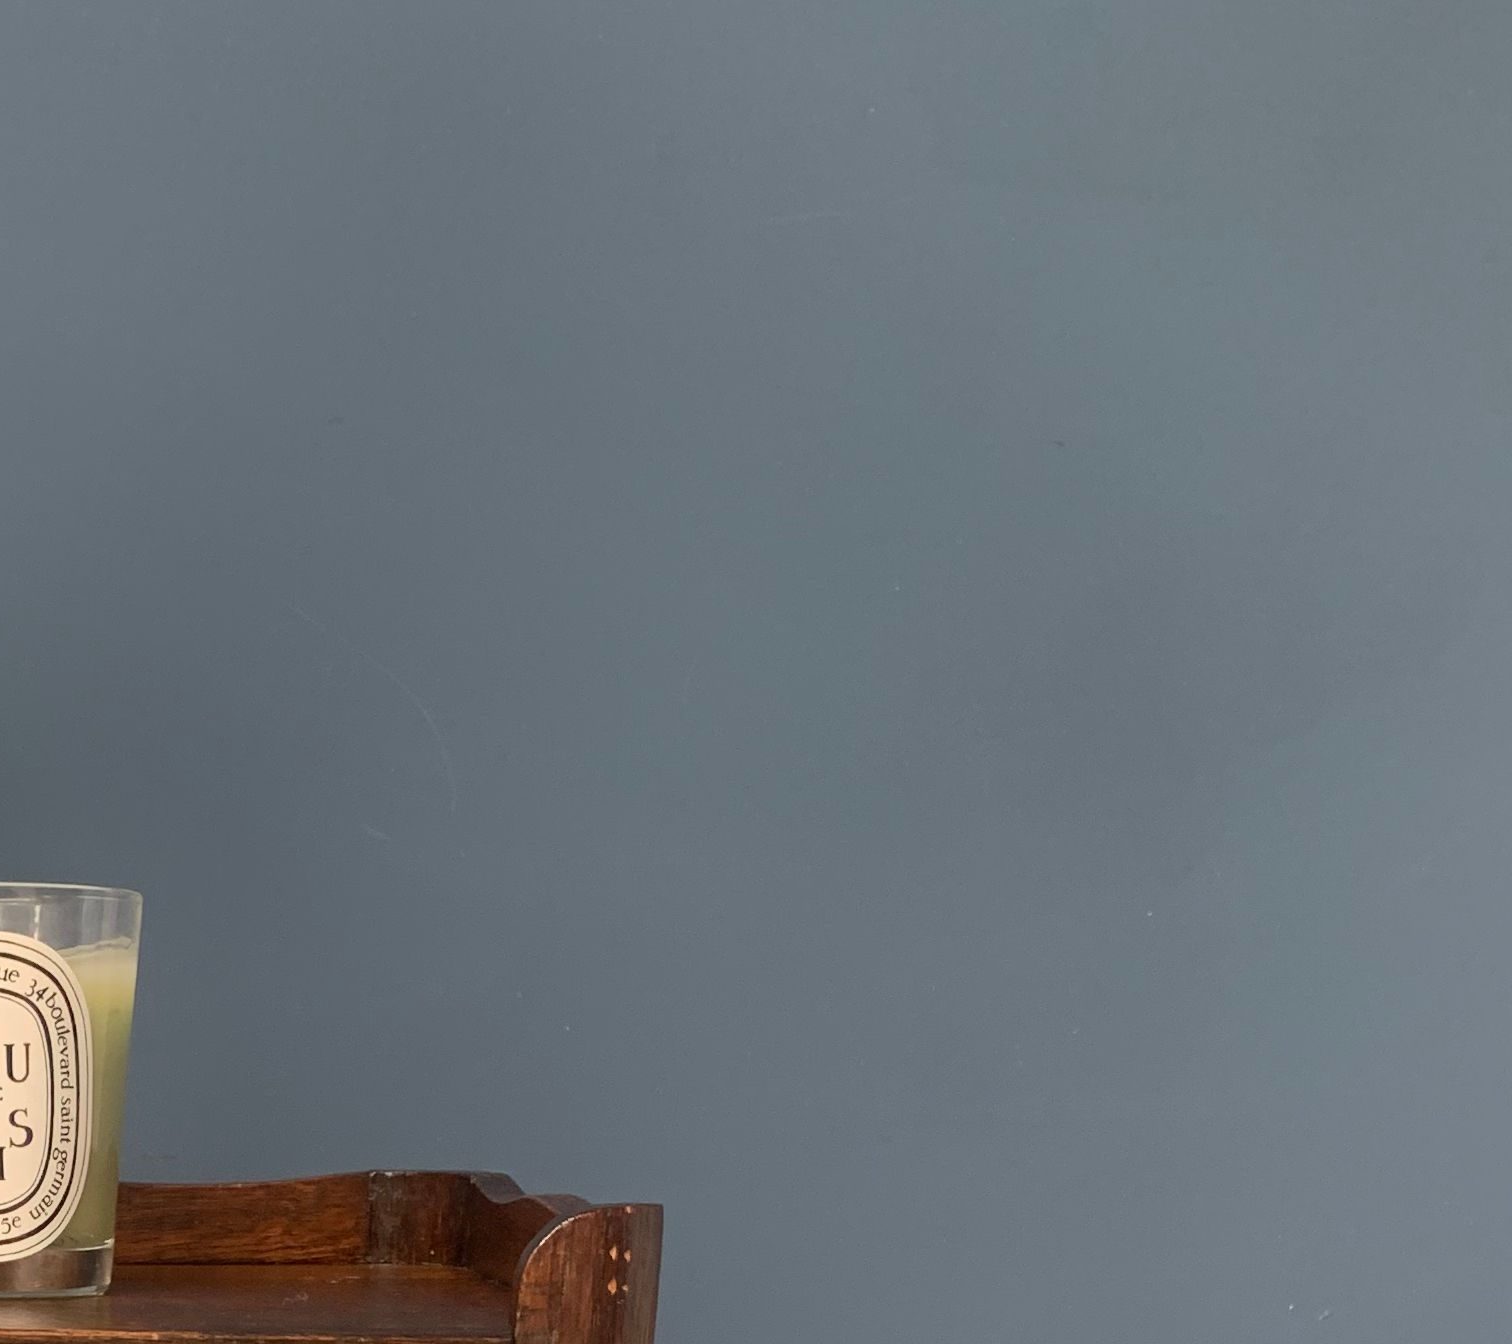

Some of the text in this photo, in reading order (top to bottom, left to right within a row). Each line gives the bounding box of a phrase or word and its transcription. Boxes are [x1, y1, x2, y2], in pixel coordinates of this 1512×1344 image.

[45, 991, 75, 1089] boulevard
[60, 1096, 73, 1143] saint
[29, 1147, 68, 1221] germain
